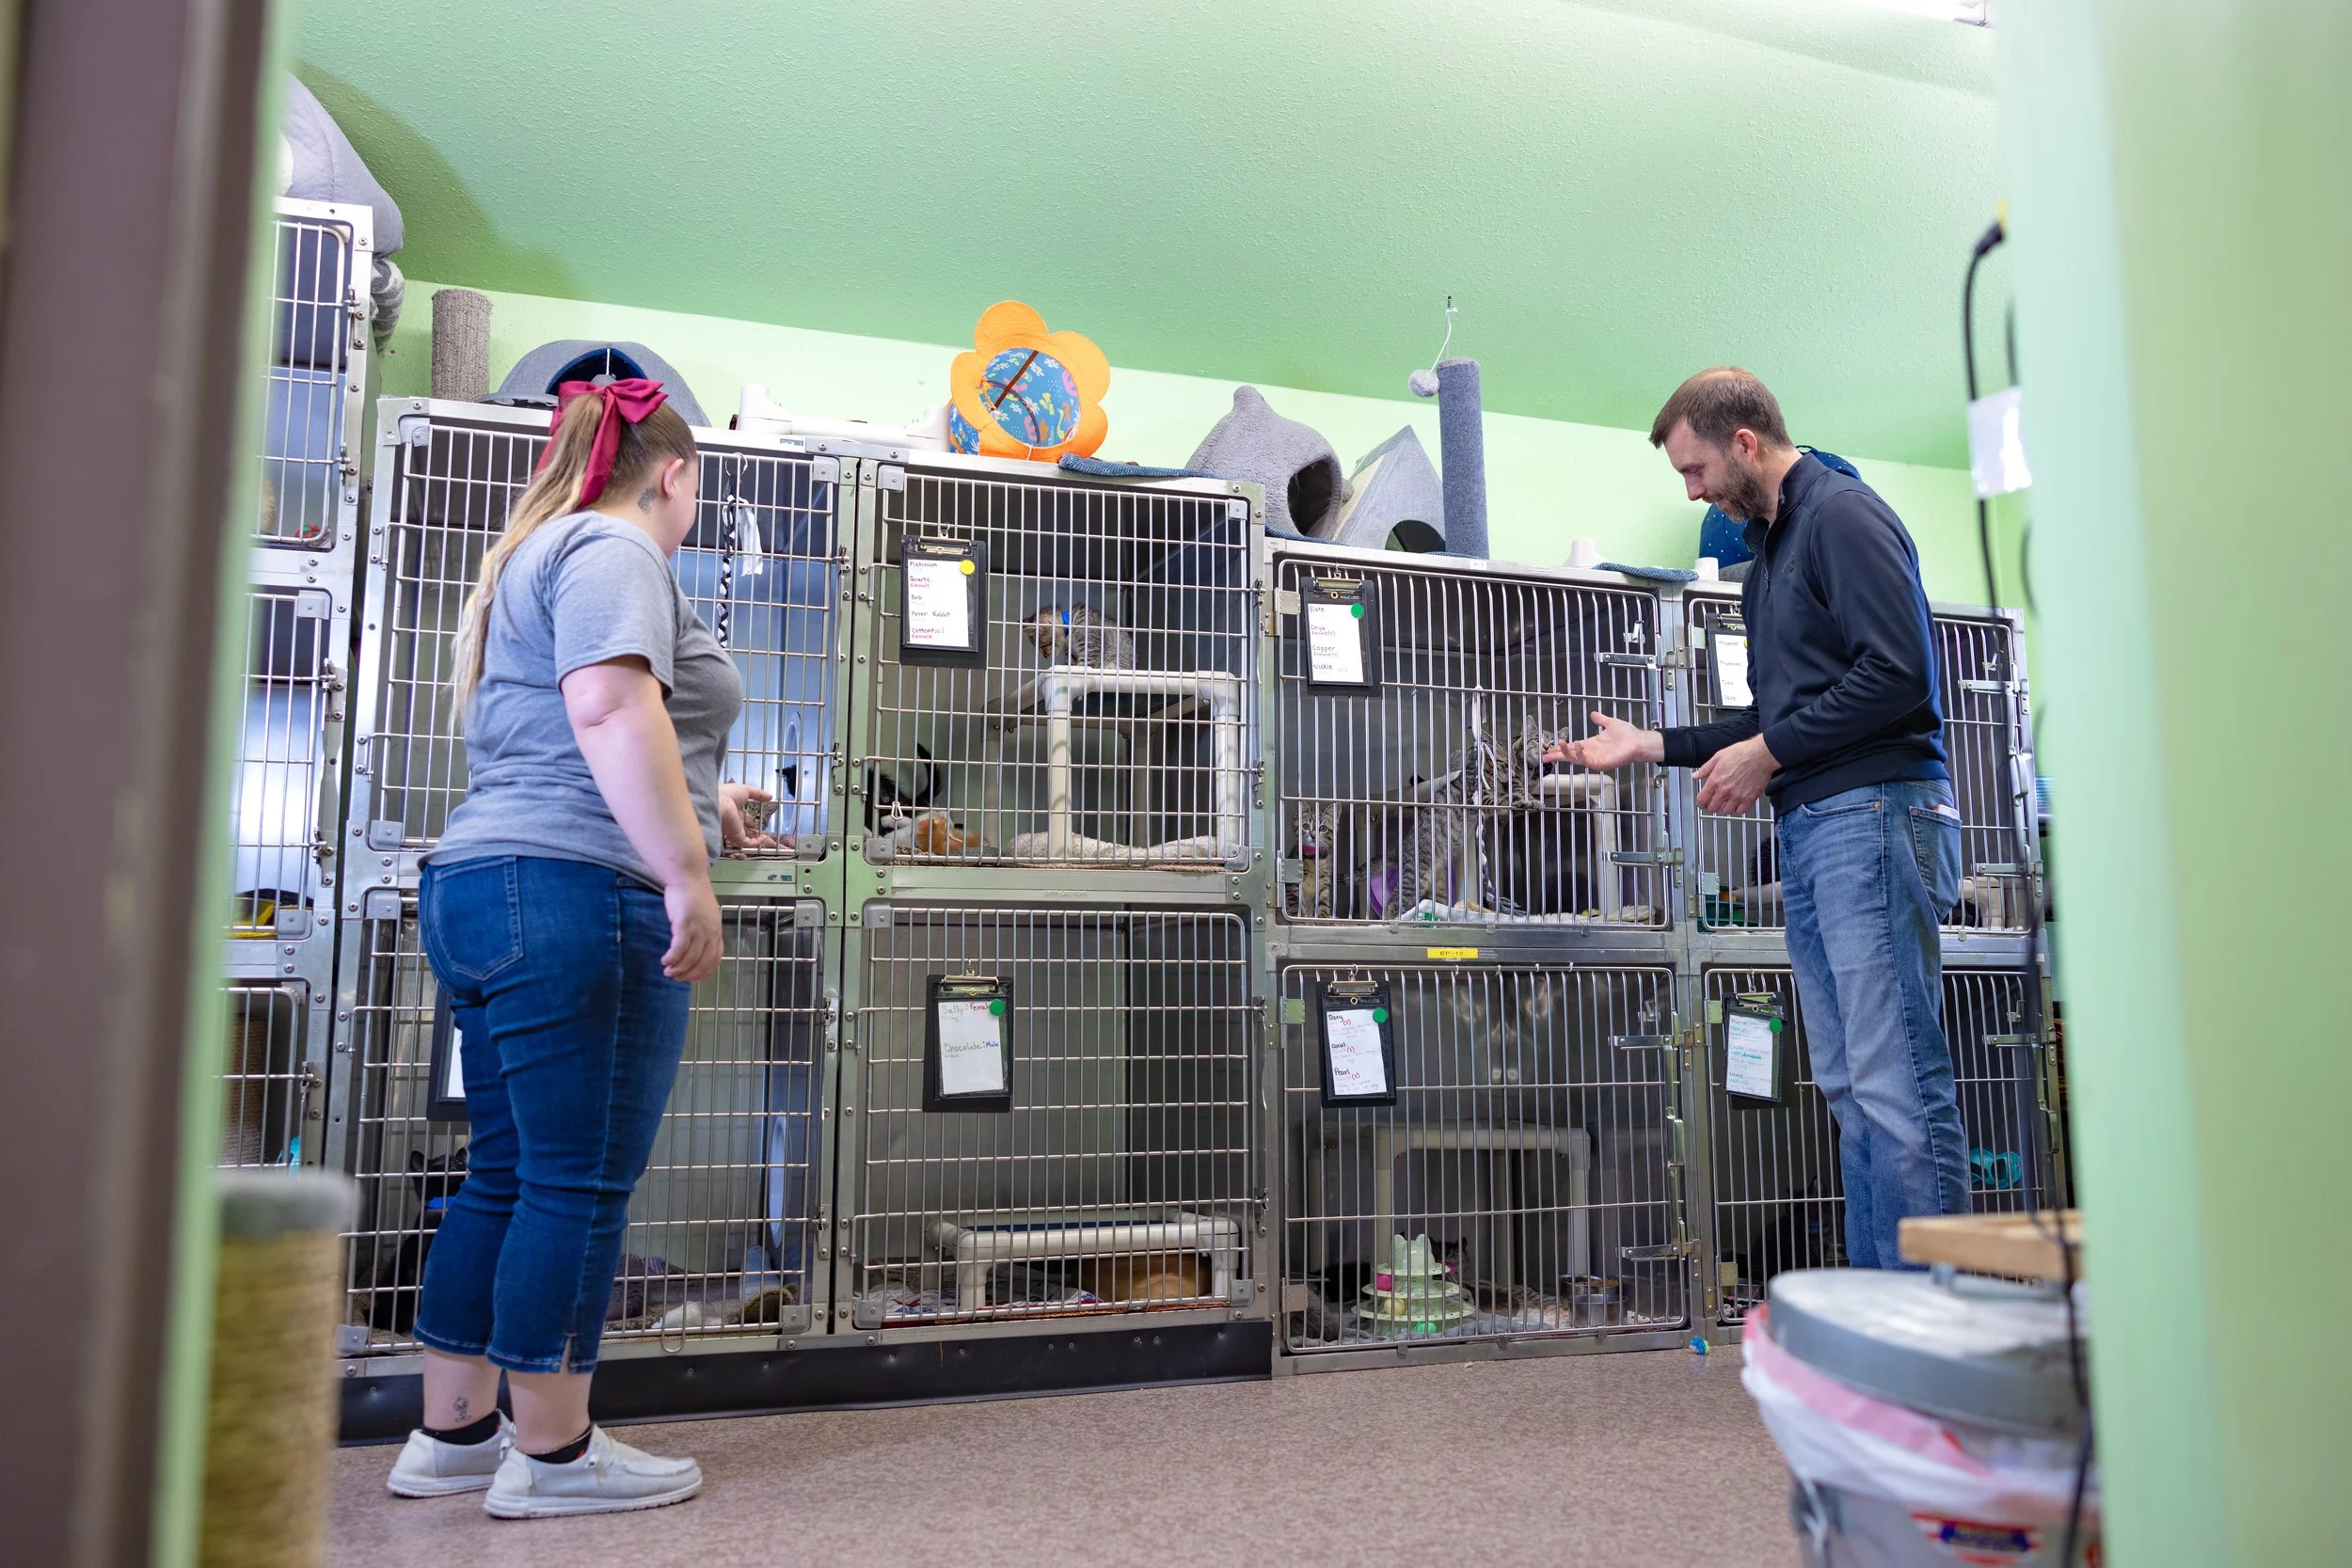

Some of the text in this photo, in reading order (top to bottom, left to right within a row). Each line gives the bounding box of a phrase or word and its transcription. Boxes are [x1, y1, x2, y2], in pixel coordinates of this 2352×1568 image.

[1311, 644, 1336, 653] Copper
[1328, 1014, 1343, 1022] Dory
[985, 1040, 1000, 1049] Male
[1334, 1067, 1351, 1076] Pearl
